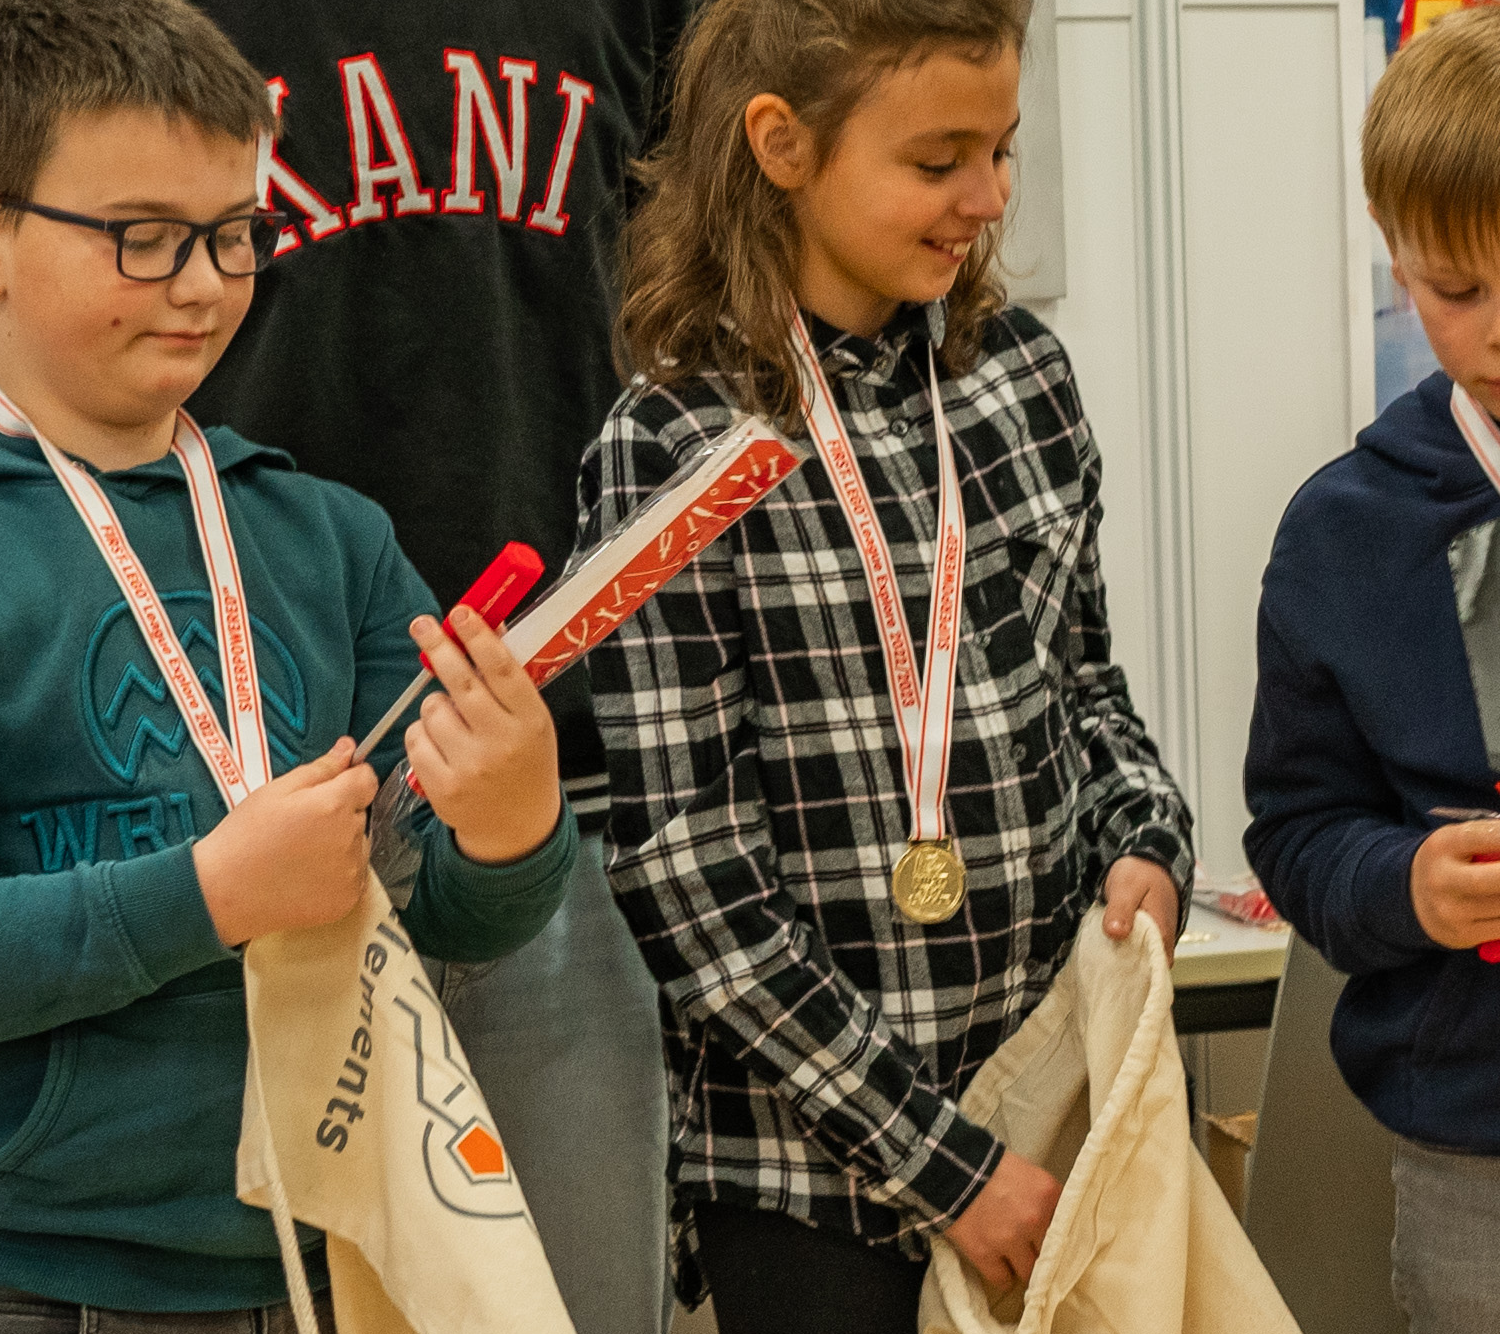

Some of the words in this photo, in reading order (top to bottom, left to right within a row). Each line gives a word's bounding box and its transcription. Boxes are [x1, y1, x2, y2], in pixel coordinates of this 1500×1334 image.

[256, 48, 594, 257] KANI
[143, 602, 172, 655] League
[169, 656, 199, 710] Explore
[195, 711, 240, 787] 2022/2023
[860, 520, 883, 572] League
[876, 573, 897, 629] Explore
[889, 630, 915, 709] 2022/2023
[315, 907, 412, 1155] lements
